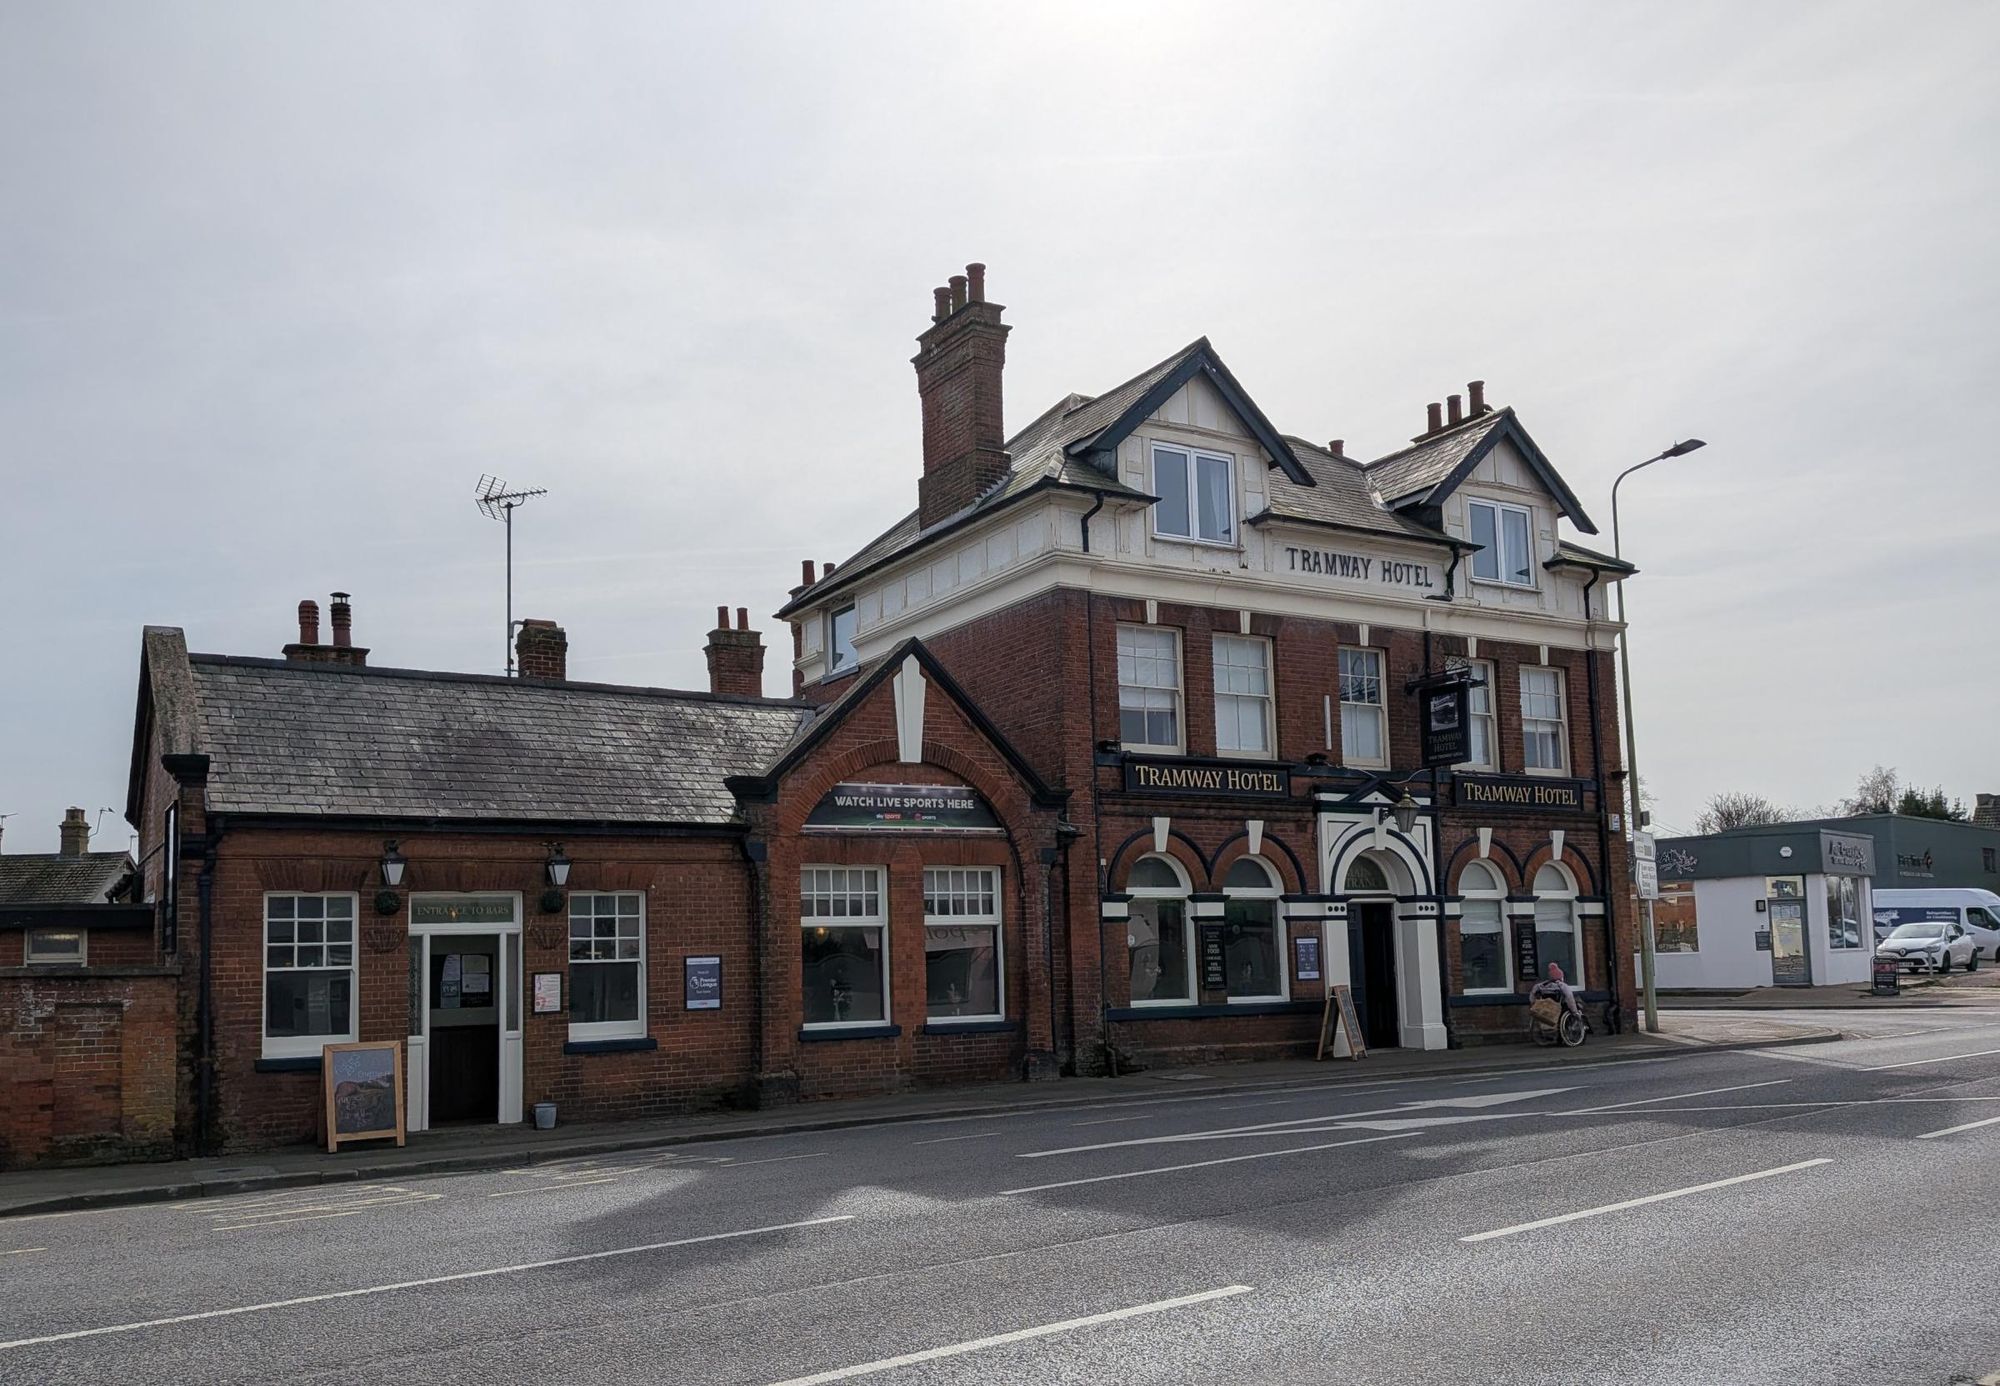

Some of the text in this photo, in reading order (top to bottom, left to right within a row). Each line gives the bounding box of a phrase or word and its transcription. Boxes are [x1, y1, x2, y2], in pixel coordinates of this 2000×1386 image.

[1285, 547, 1433, 588] TRAMWAY HOTEL
[1135, 765, 1282, 791] TRAMWAY HOTEL
[835, 796, 974, 809] WATCH LIVE SPORTS HERE
[1464, 782, 1577, 805] TRAMWAY HOTEL
